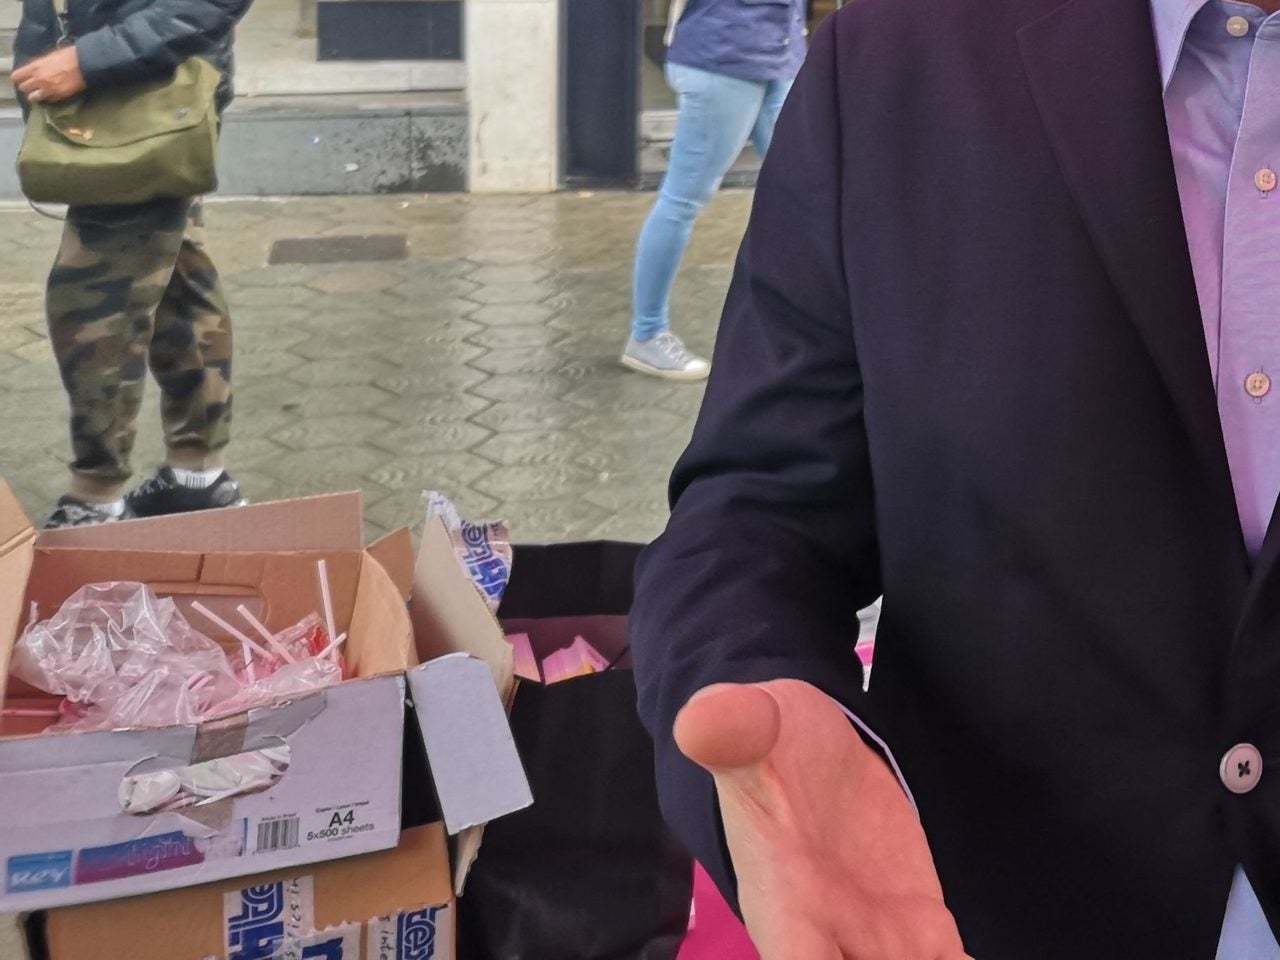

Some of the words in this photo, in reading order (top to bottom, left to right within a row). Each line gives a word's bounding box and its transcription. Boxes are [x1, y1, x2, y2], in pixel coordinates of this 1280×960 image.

[328, 809, 355, 828] A4
[306, 827, 339, 841] 5x500
[341, 823, 375, 836] sheets
